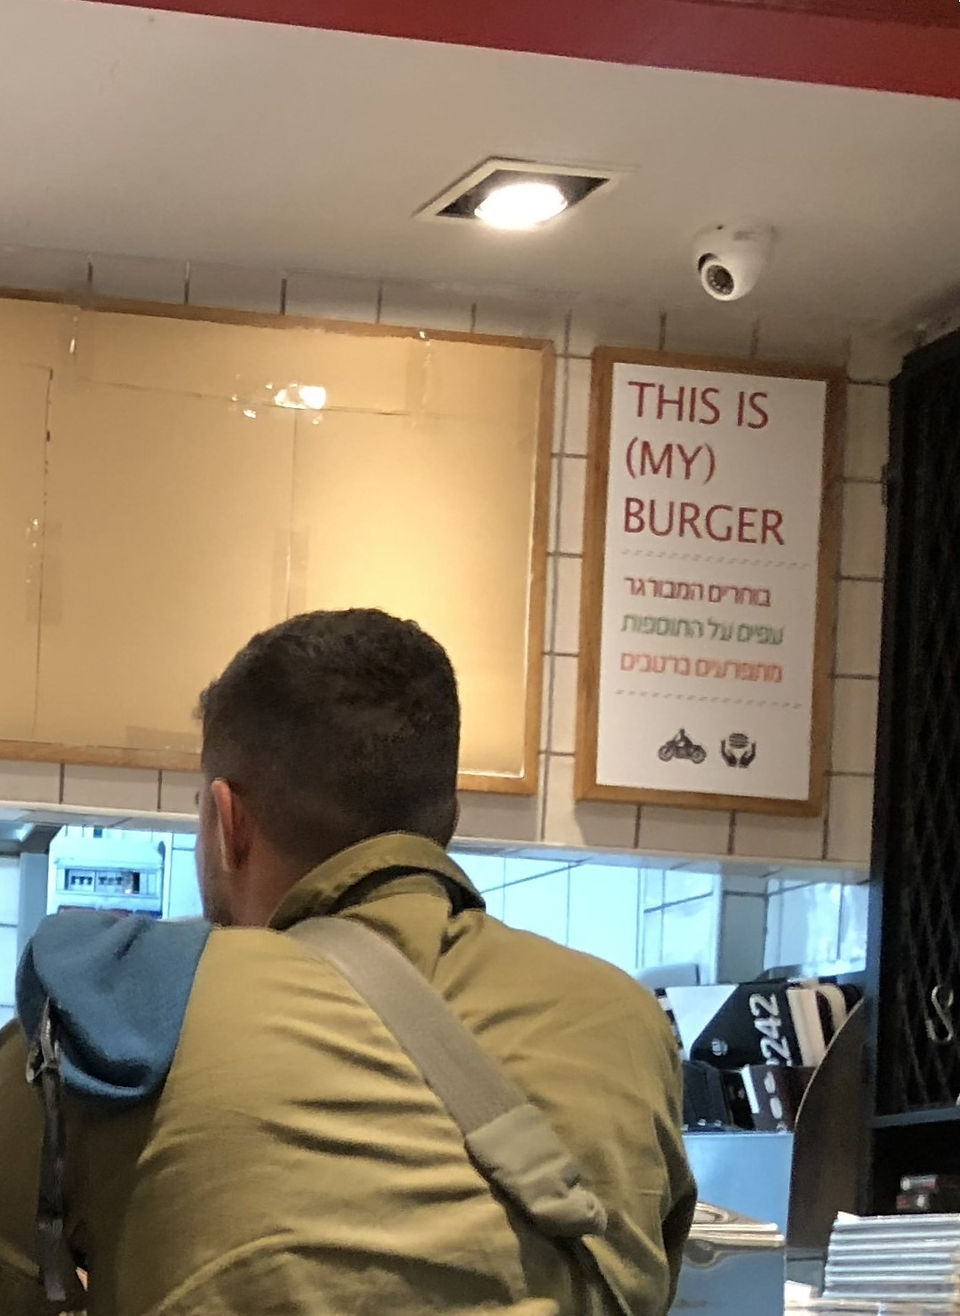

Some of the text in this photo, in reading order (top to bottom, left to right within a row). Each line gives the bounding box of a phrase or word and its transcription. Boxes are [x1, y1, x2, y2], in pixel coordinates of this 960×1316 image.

[628, 382, 769, 430] THIS IS
[626, 437, 716, 484] (MY)
[624, 497, 785, 545] BURGER
[624, 577, 771, 607] בוחרים המבורגר
[621, 614, 784, 645] עפים על התוספות
[749, 993, 793, 1067] 242
